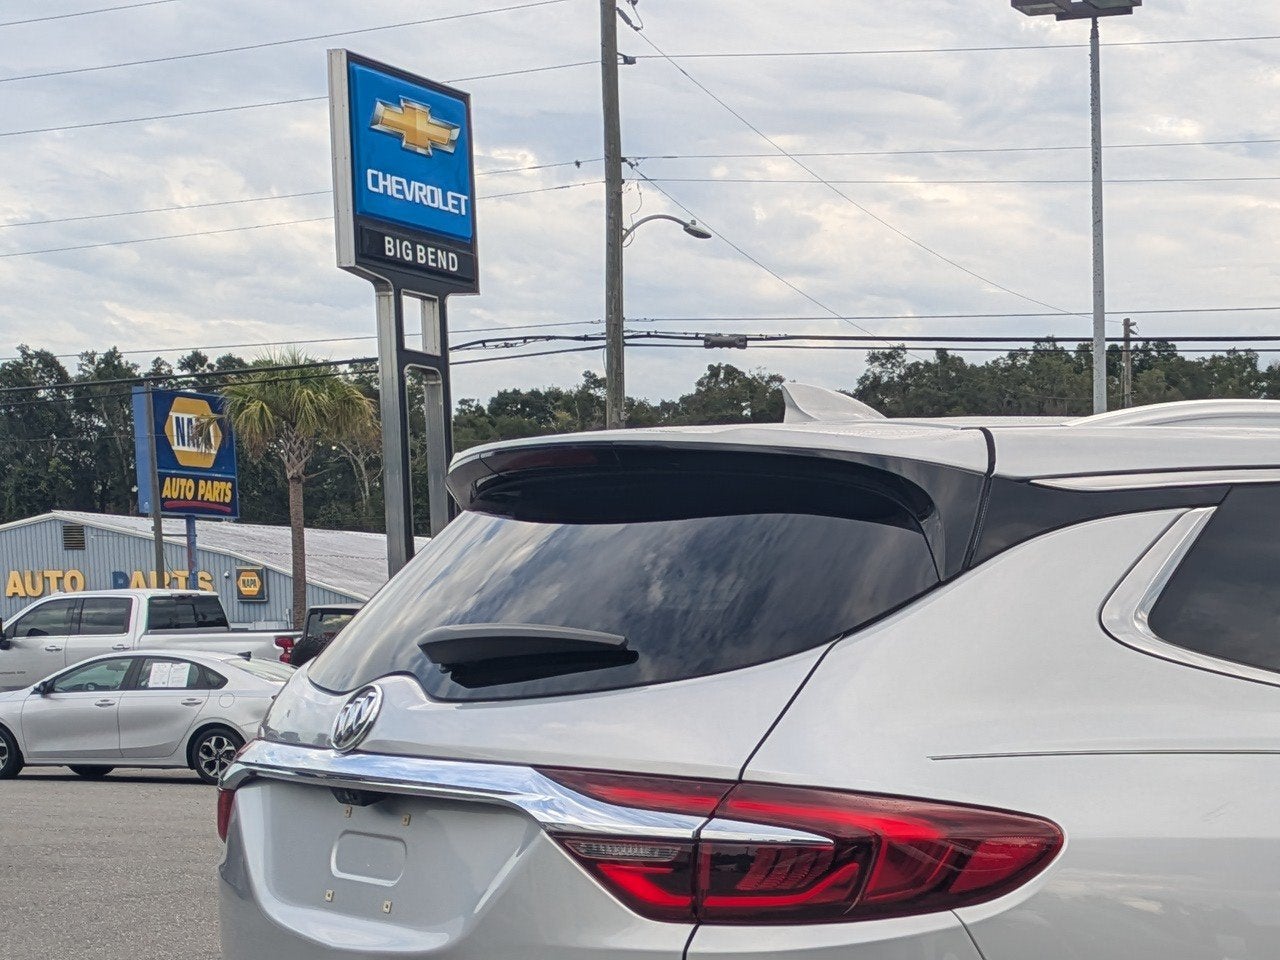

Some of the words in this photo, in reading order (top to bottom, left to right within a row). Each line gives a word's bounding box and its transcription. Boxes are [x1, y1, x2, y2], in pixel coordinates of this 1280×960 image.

[367, 169, 468, 215] CHEVROLET
[384, 236, 412, 262] BIG
[416, 244, 458, 272] BEND
[174, 415, 214, 452] NA
[161, 477, 195, 500] AUTO
[198, 481, 232, 503] PARTS
[5, 570, 85, 598] AUTO
[111, 570, 214, 593] PARTS
